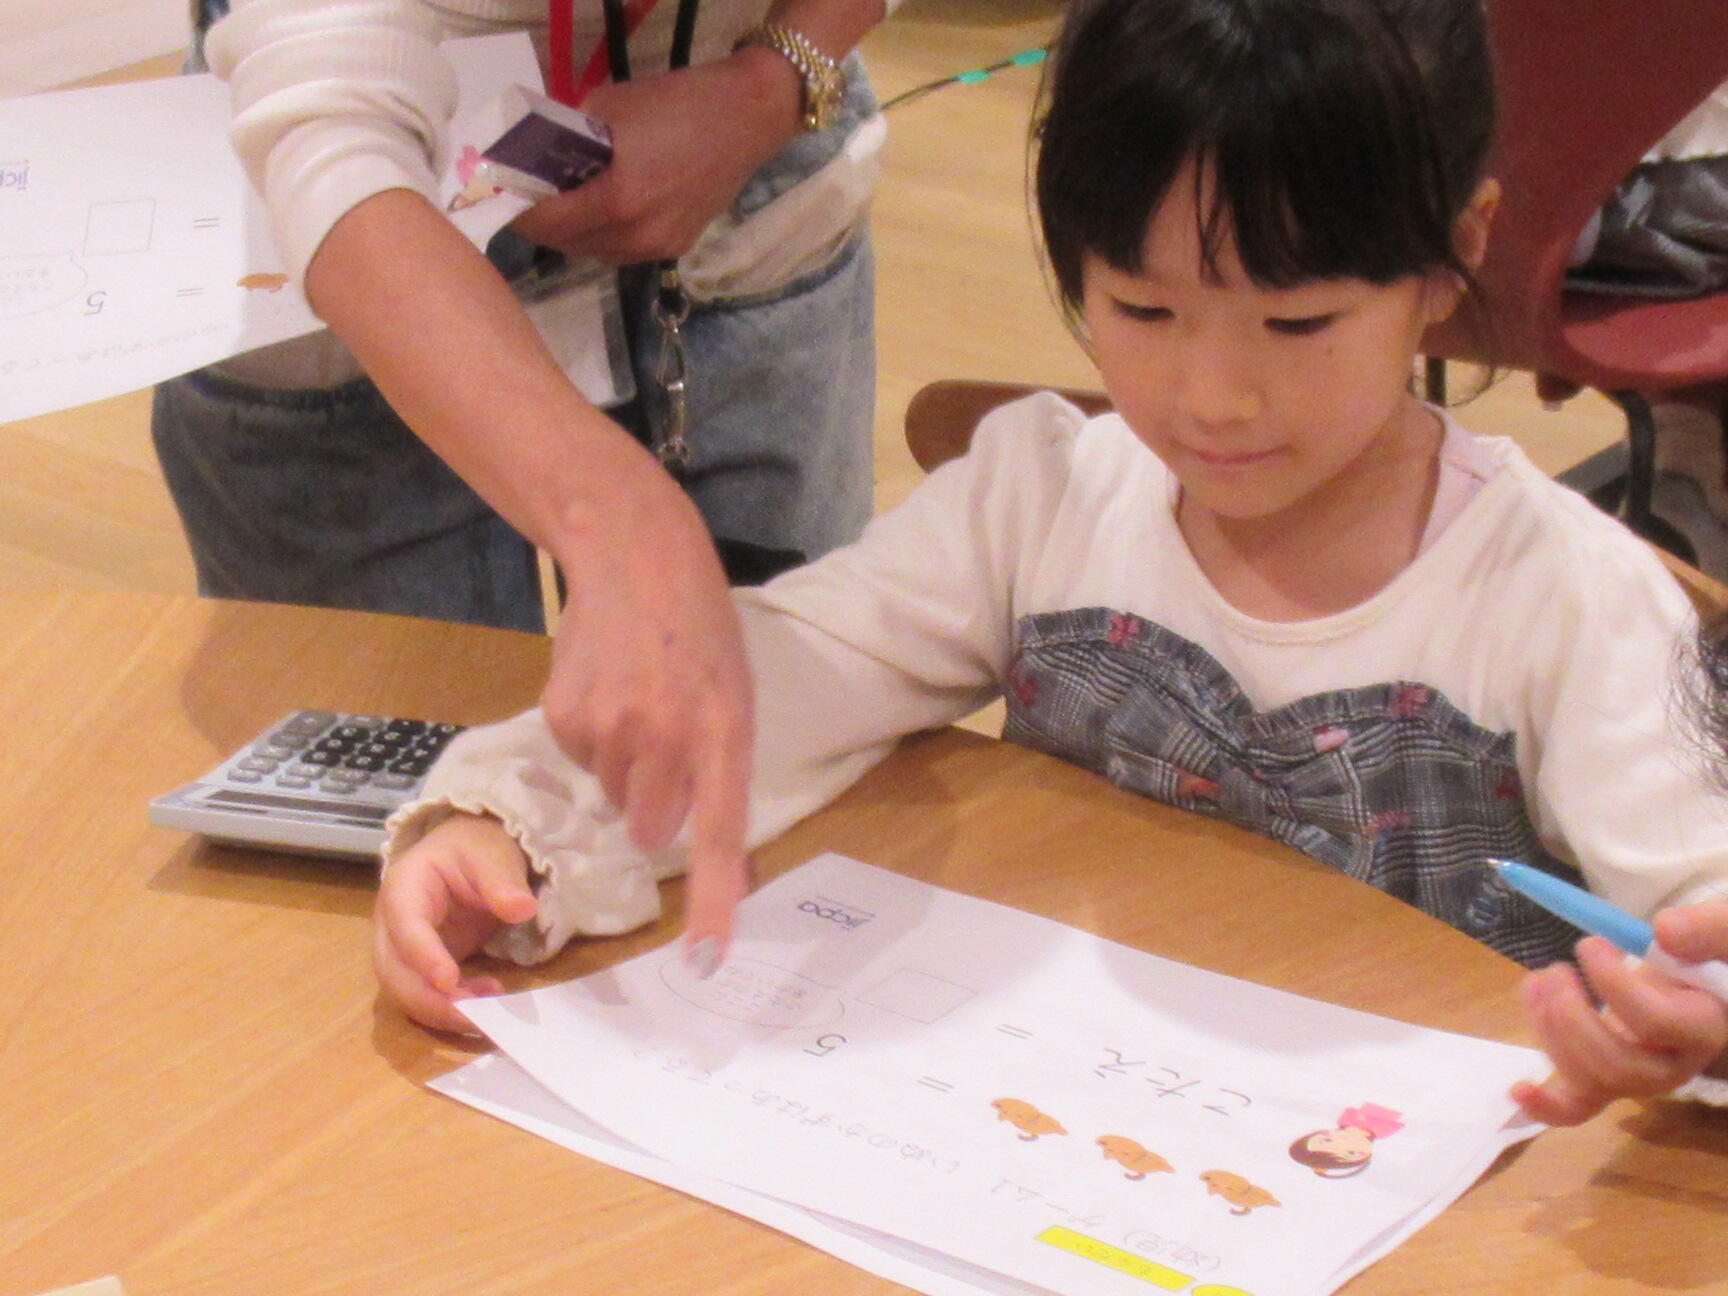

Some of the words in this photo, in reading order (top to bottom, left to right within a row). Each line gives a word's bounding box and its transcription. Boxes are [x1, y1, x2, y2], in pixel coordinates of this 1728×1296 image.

[83, 289, 107, 316] 5
[796, 901, 864, 930] jicpa
[801, 1032, 849, 1058] 5
[1092, 1046, 1253, 1118] こたえ
